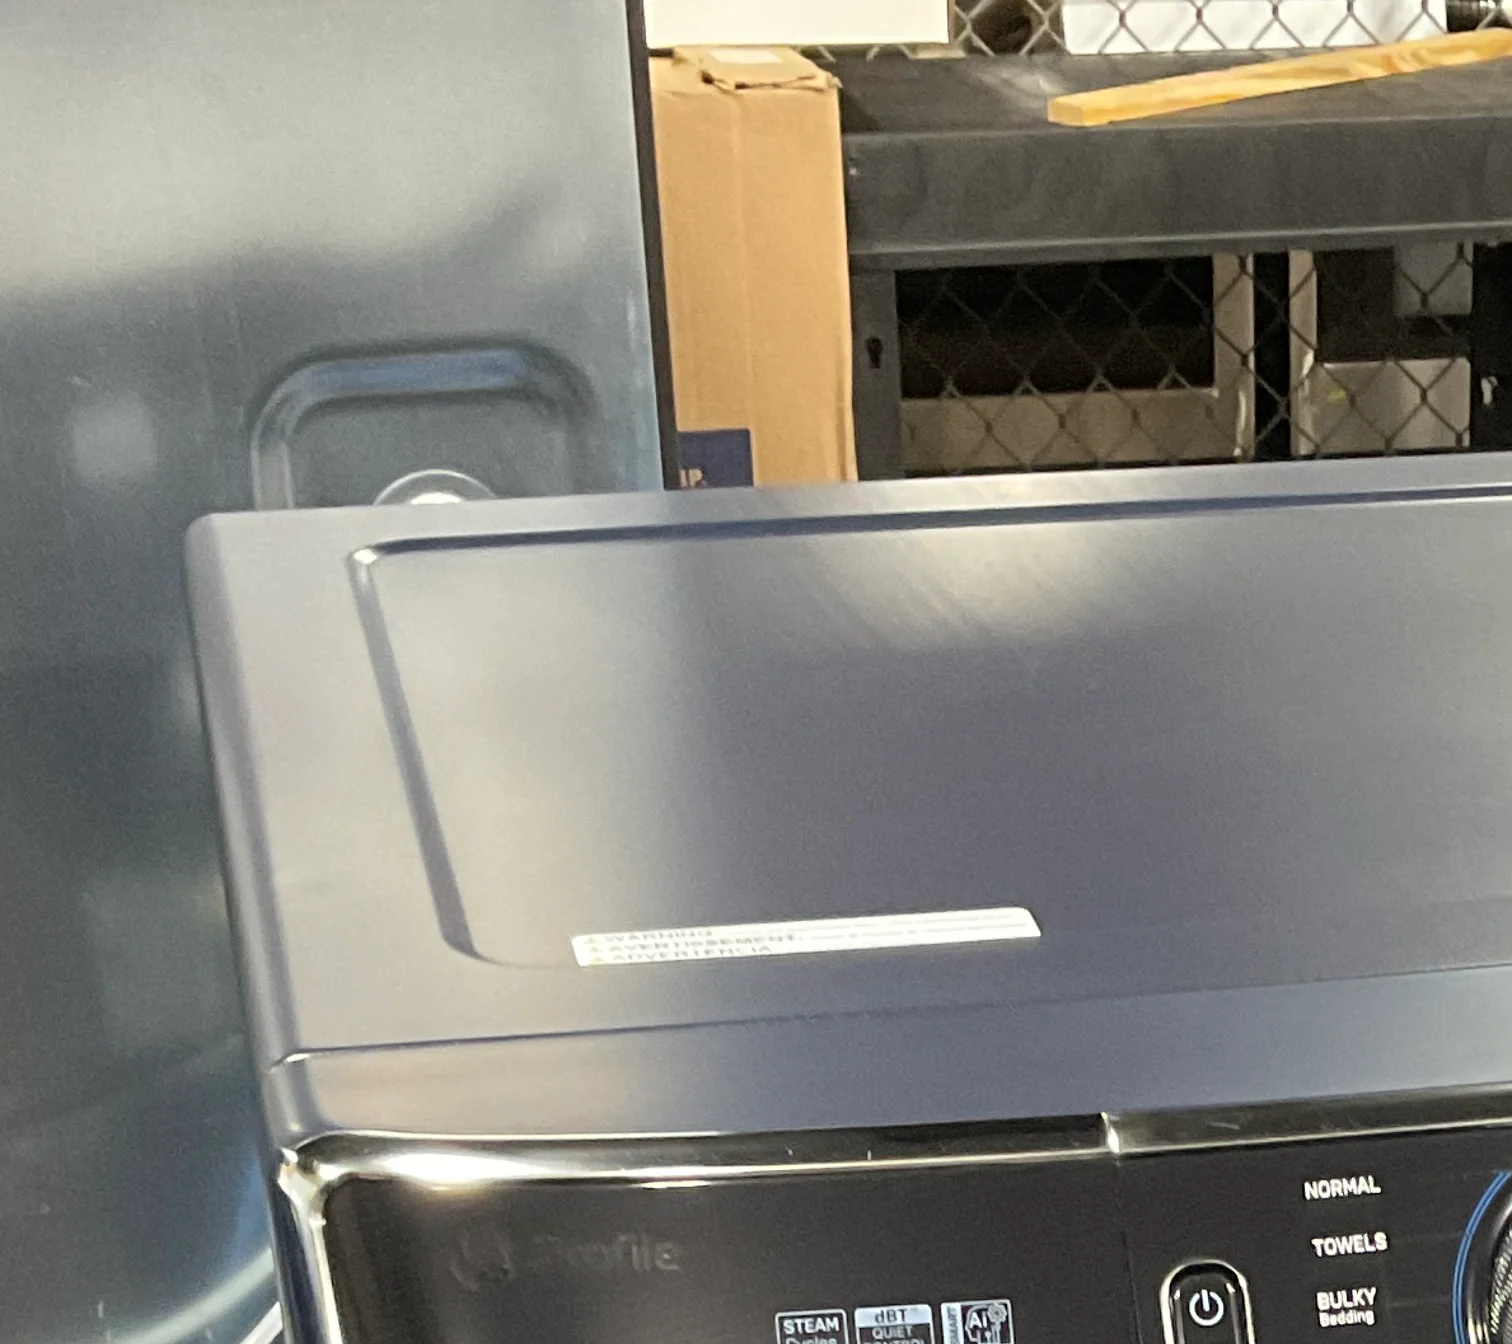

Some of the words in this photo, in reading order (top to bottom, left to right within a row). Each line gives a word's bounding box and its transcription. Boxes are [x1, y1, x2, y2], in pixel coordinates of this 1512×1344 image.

[1304, 1176, 1381, 1200] NORMAL
[1311, 1232, 1388, 1257] TOWELS
[1316, 1286, 1377, 1311] BULKY
[783, 1316, 840, 1335] STEAM
[874, 1307, 909, 1324] dBT
[1319, 1308, 1375, 1328] Bedding
[871, 1325, 915, 1340] QUIET
